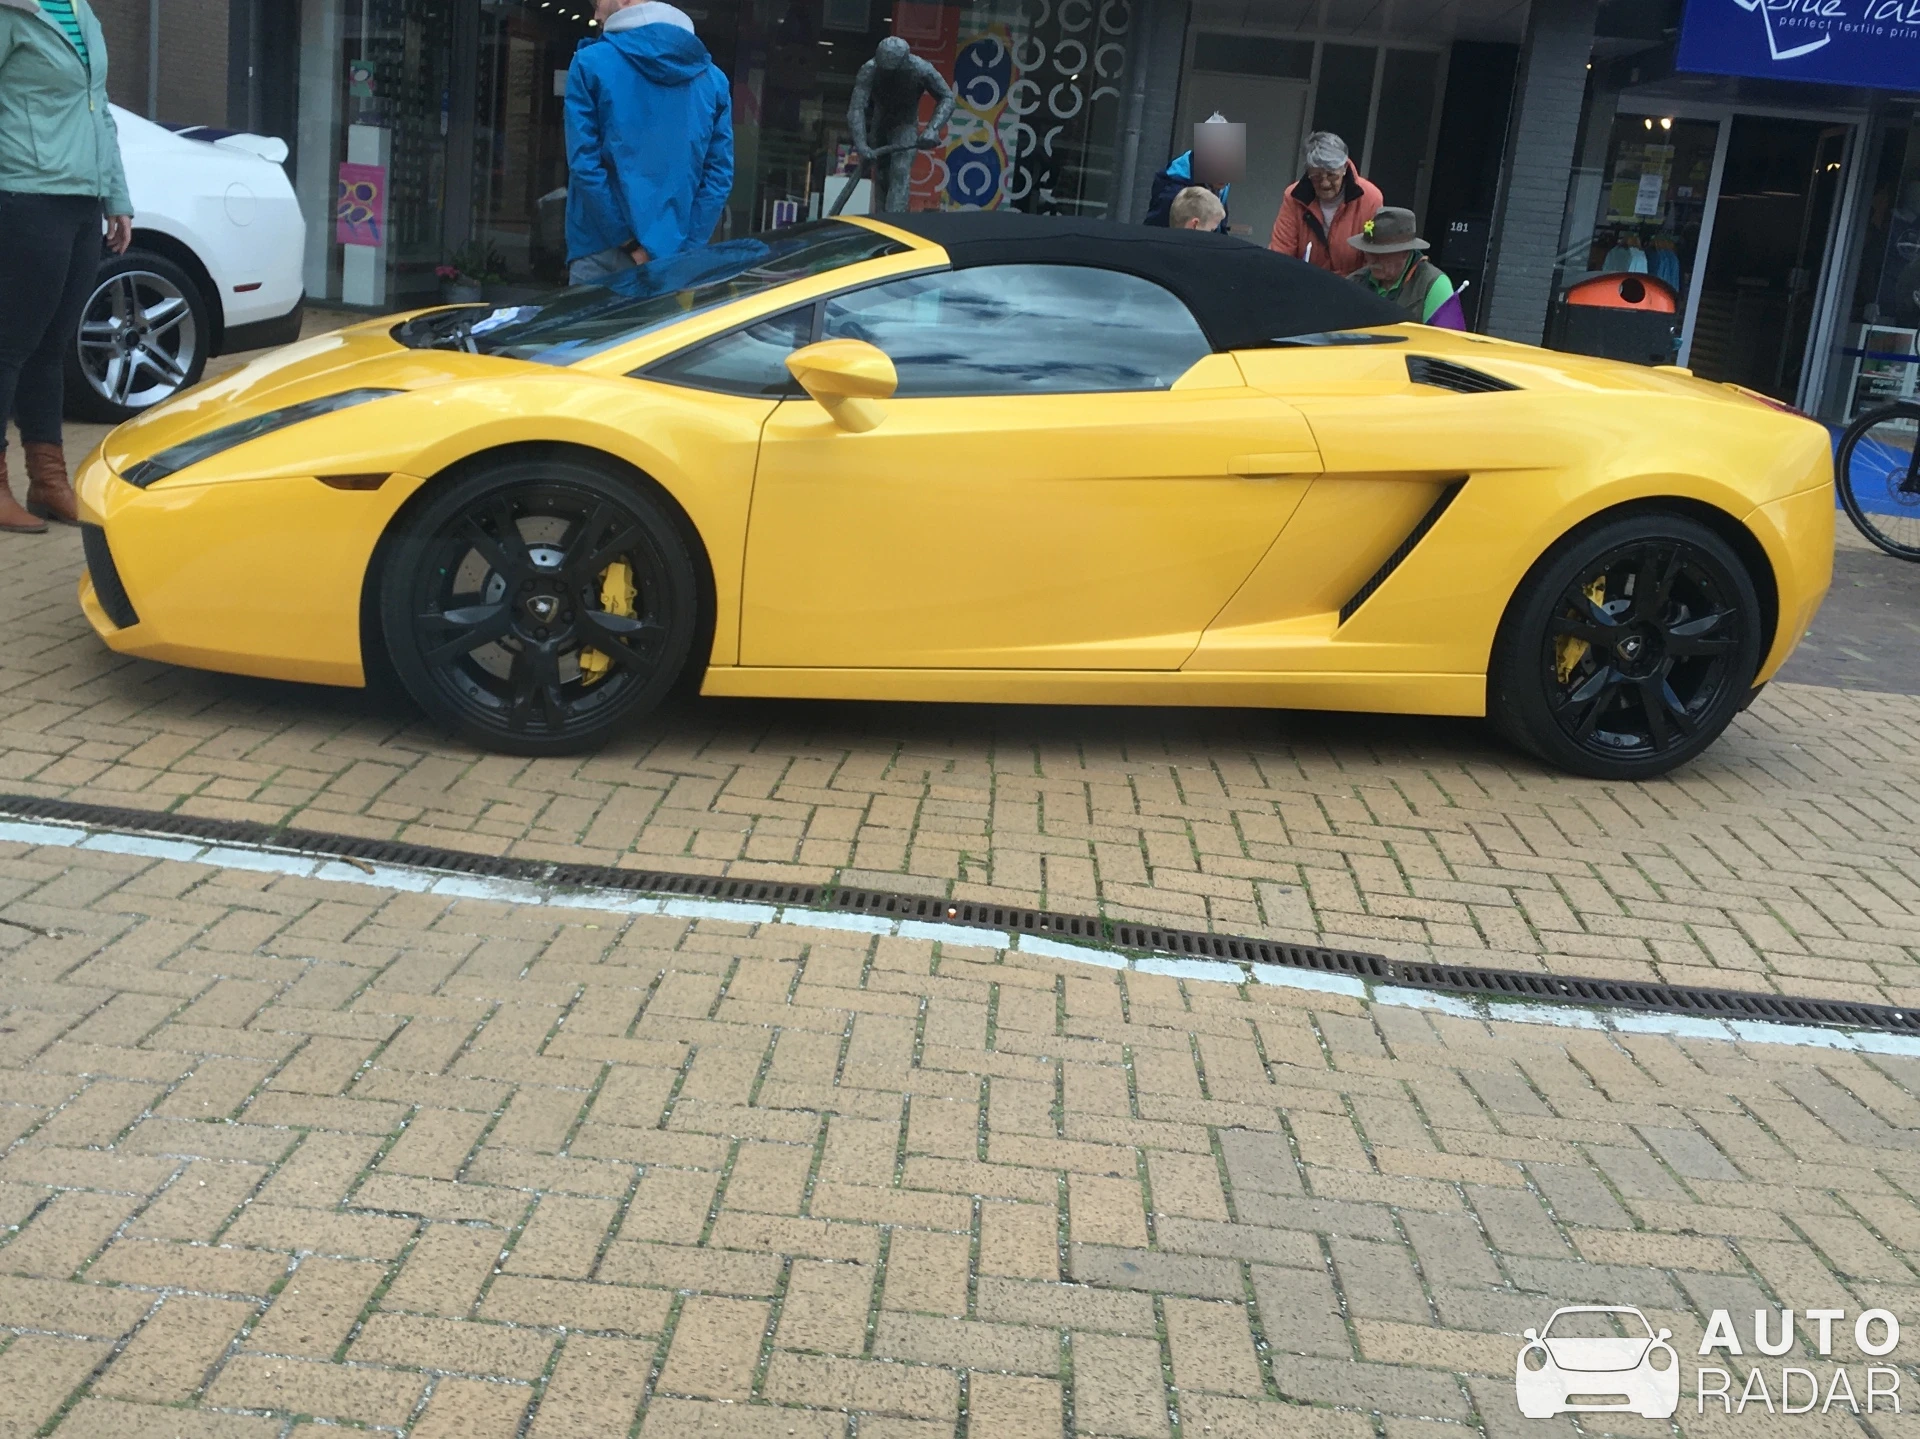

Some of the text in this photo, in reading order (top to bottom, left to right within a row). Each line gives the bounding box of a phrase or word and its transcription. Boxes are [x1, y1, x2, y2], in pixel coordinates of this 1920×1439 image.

[1779, 16, 1832, 30] perfect
[1838, 21, 1884, 35] textile
[1450, 221, 1469, 232] 181
